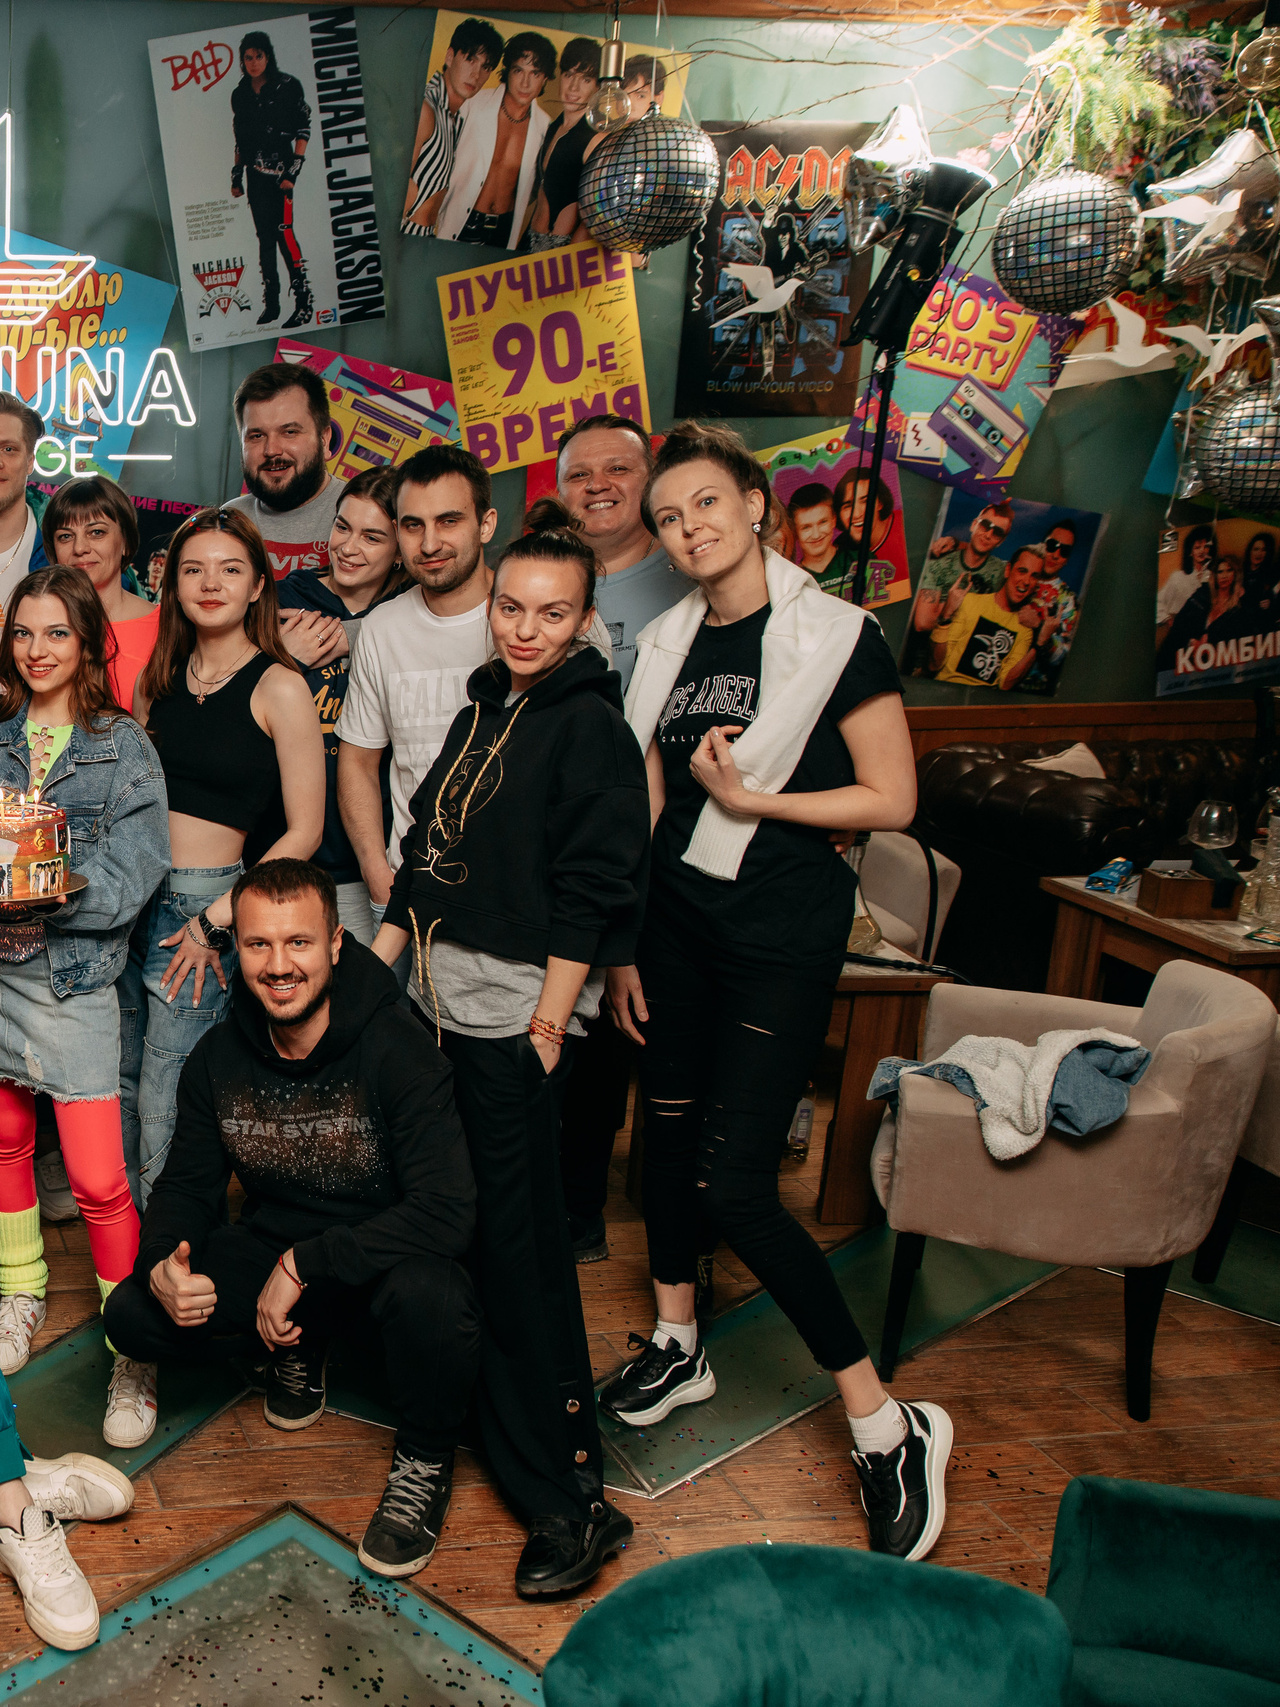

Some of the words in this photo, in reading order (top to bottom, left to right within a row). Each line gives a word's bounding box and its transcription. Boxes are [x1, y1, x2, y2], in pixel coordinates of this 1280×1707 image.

[161, 40, 234, 92] BAD
[308, 7, 371, 169] MICHAEL
[192, 256, 245, 275] MICHAEL
[325, 160, 387, 326] JACKSON
[203, 271, 238, 286] JACKSON
[448, 246, 627, 321] ЛУЧШЕЕ
[926, 281, 1024, 344] 90'S
[909, 324, 1010, 376] PARTY
[706, 380, 742, 392] BLOW
[744, 381, 761, 393] UP
[763, 381, 796, 393] YOUR
[797, 380, 835, 393] VIDEO
[267, 551, 322, 571] VI'S
[396, 674, 469, 721] CALV
[687, 674, 759, 723] ANGEL
[221, 1119, 278, 1138] STAR
